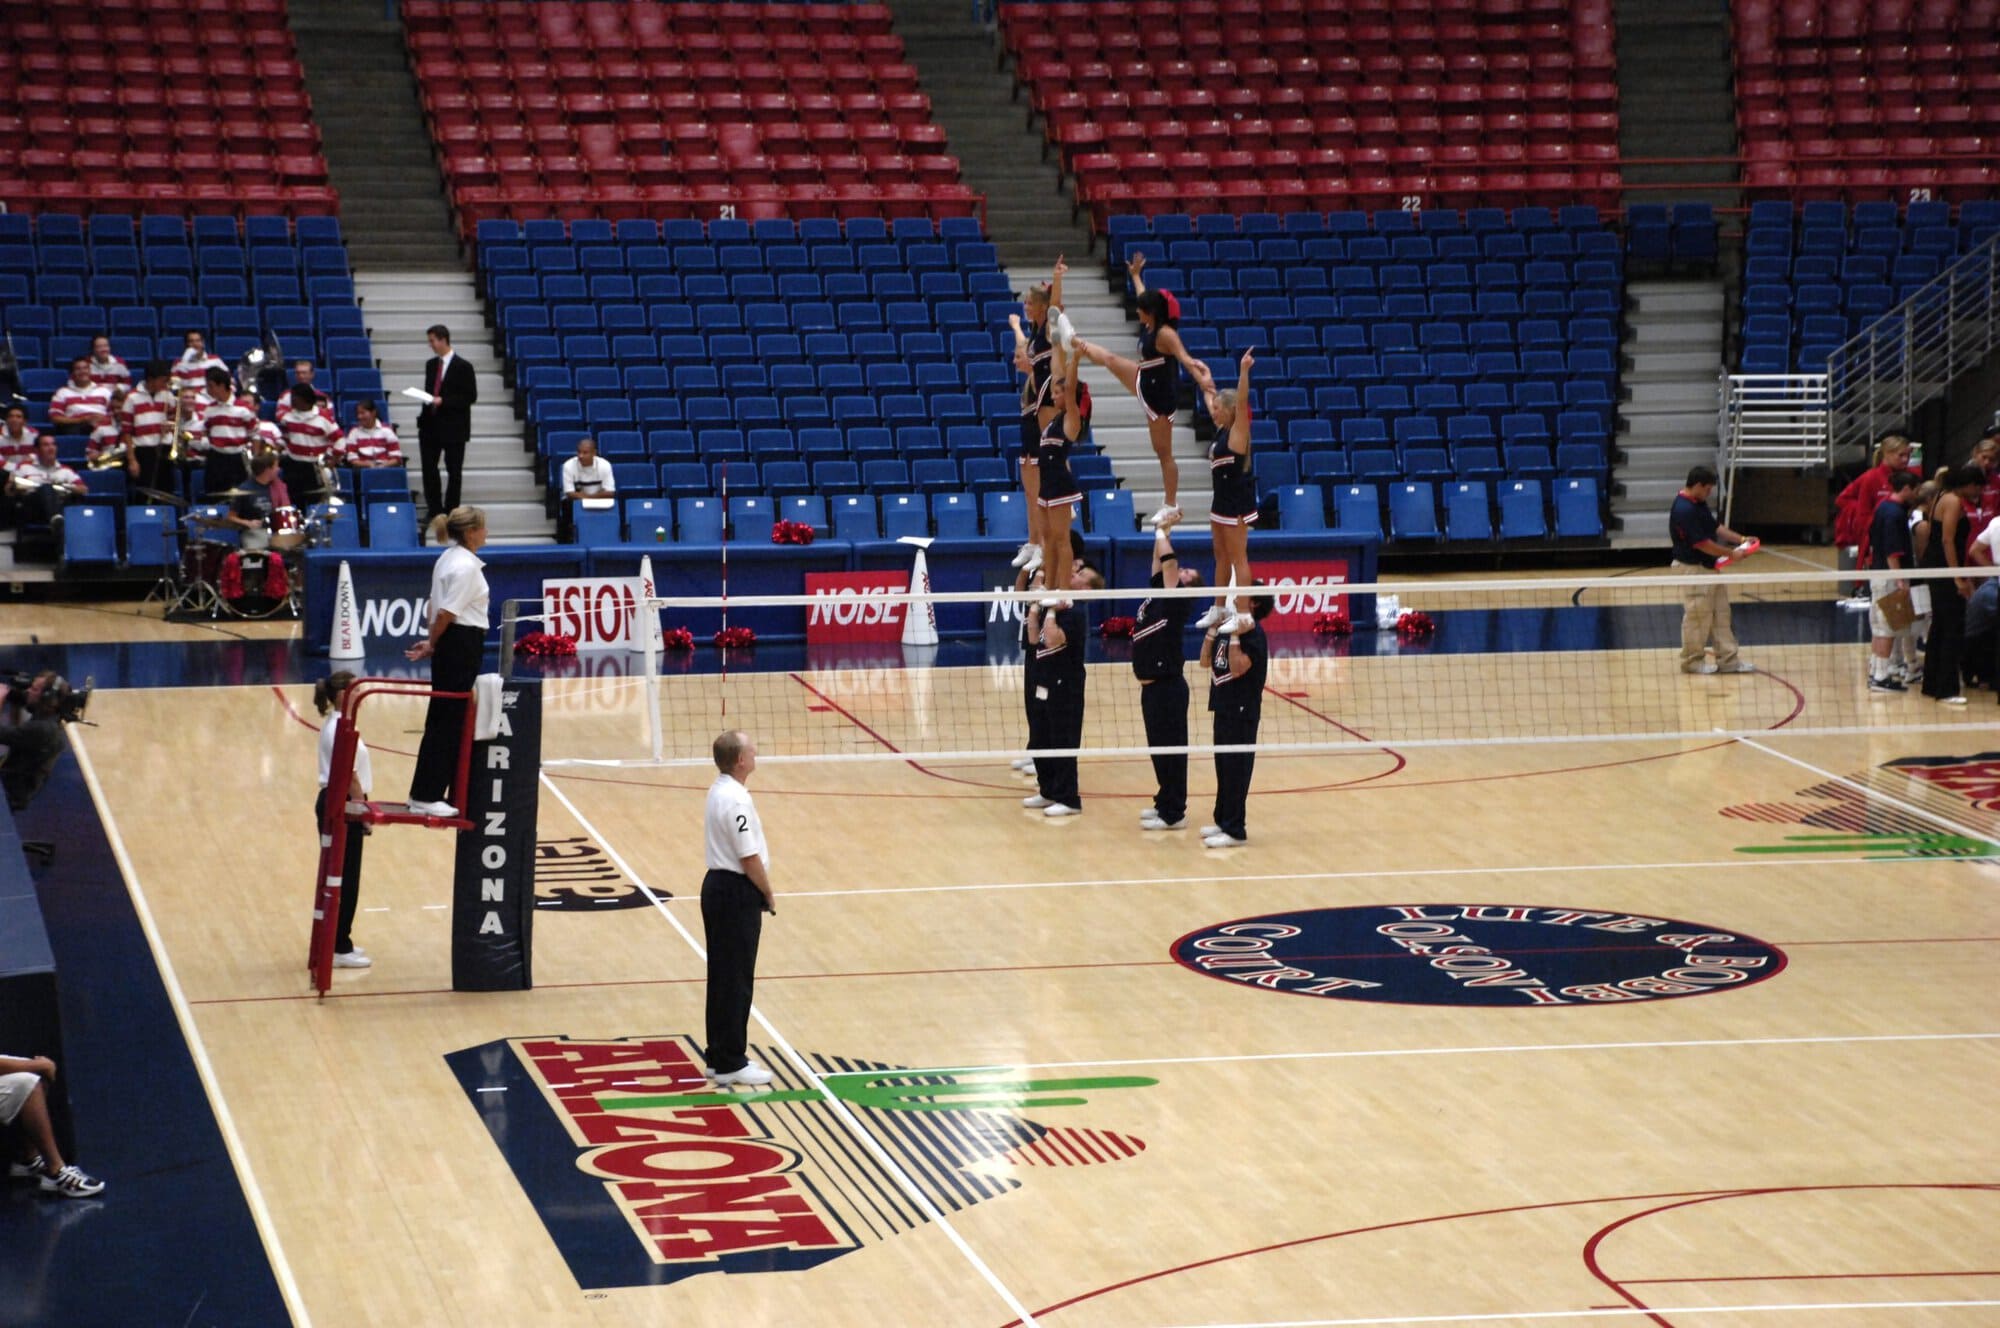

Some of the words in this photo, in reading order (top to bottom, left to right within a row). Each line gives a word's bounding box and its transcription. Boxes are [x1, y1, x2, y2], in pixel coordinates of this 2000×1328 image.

[720, 205, 735, 221] 21
[1402, 196, 1421, 212] 22
[810, 586, 906, 625] NOISE
[479, 712, 513, 935] ARIZONA
[736, 814, 749, 833] 2
[1386, 905, 1668, 933] LUTE
[1193, 923, 1383, 995] COURT
[1376, 922, 1546, 987] OLSON
[1655, 933, 1735, 953] &
[1513, 954, 1768, 1005] BOBBI
[521, 1040, 840, 1260] ARIZONA
